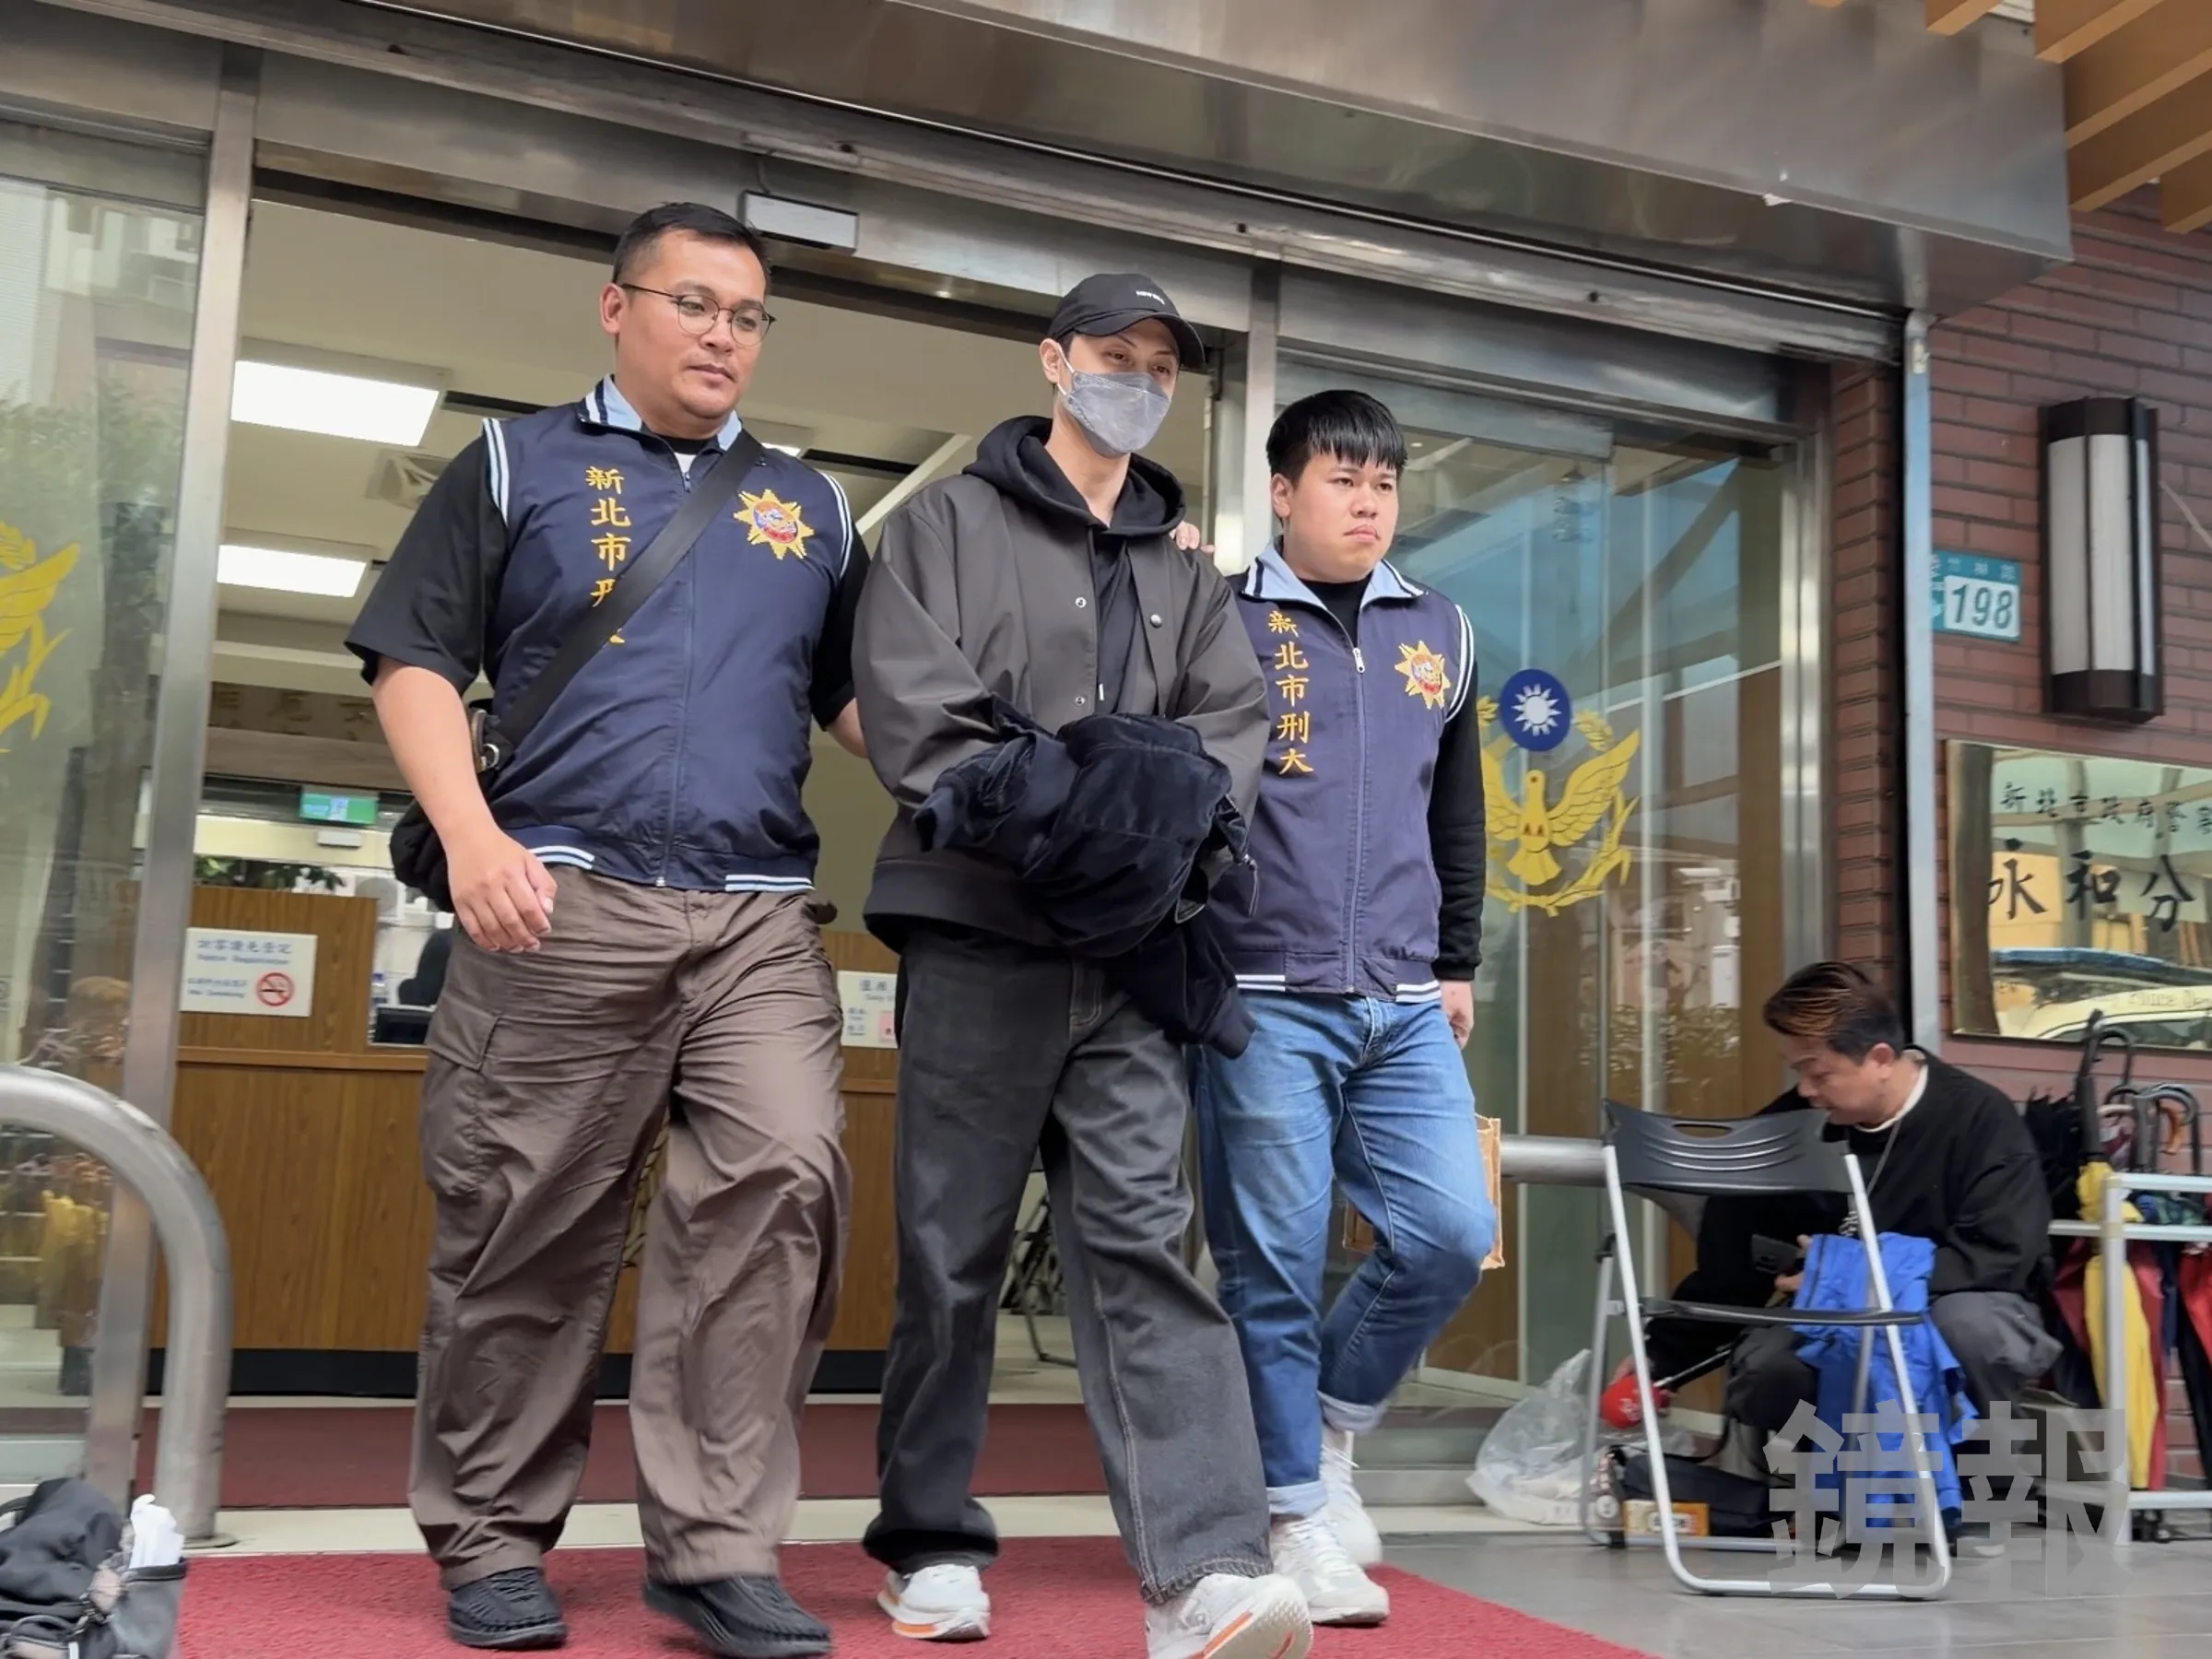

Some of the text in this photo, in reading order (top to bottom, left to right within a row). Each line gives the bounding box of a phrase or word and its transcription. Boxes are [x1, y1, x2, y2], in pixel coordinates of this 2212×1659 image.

[584, 465, 631, 644] 新北市
[1951, 582, 2013, 629] 198
[1268, 610, 1314, 775] 新北市刑大
[1987, 837, 2195, 933] 永和分
